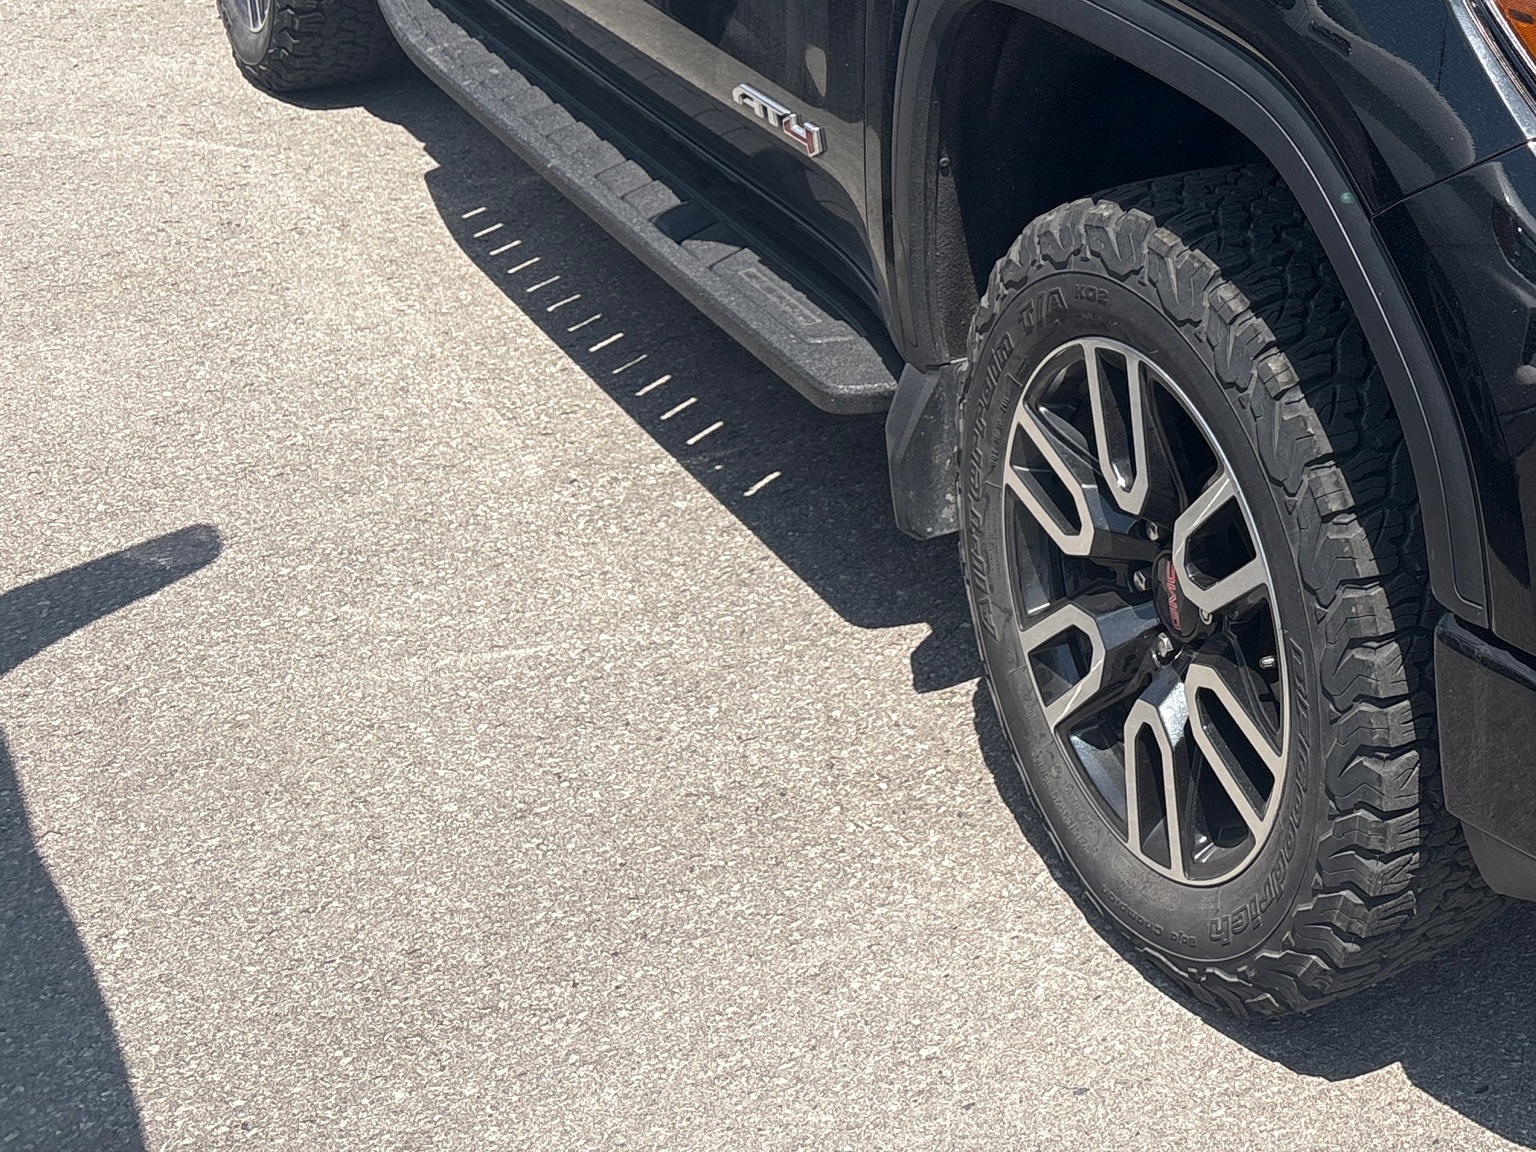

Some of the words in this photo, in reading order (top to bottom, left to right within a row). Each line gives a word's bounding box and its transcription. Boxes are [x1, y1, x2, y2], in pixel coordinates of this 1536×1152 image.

[732, 83, 820, 157] AT4
[1016, 286, 1069, 336] T/A
[1166, 560, 1181, 630] GMC
[1101, 884, 1164, 938] Champion
[1170, 930, 1198, 948] Baja
